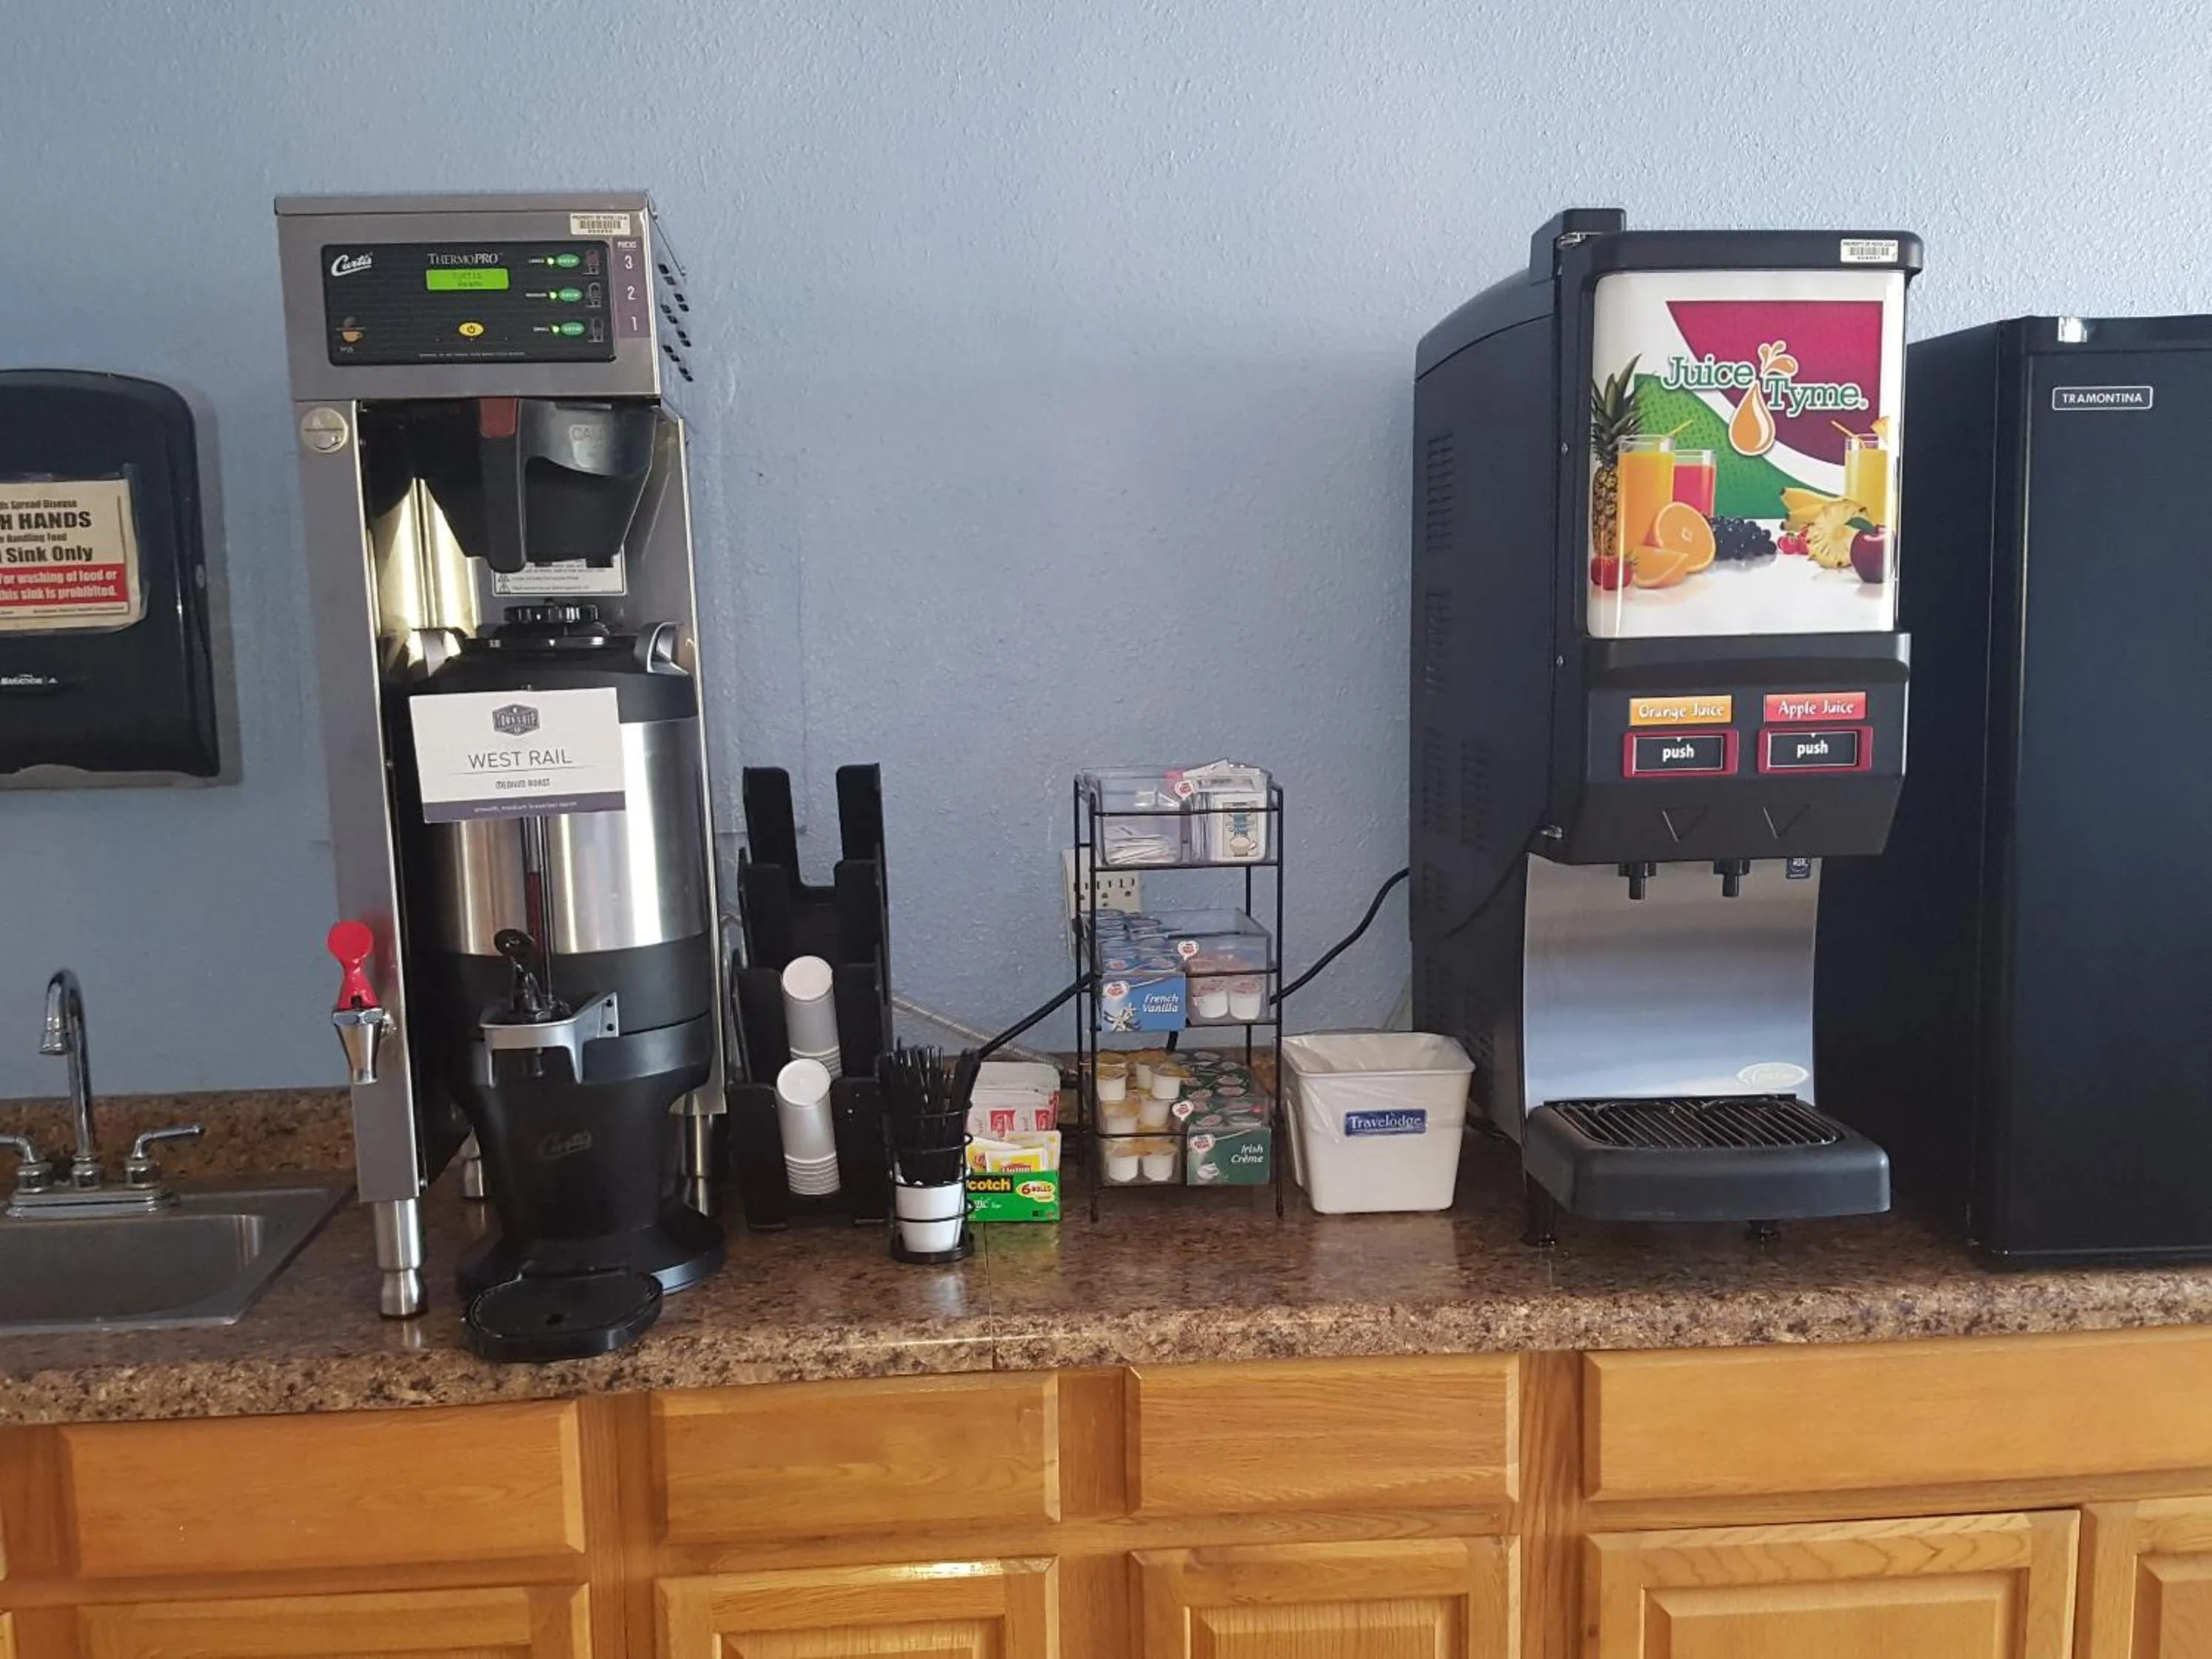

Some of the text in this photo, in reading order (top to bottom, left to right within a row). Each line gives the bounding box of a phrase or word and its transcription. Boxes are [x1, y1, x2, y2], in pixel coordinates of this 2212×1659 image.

[332, 253, 373, 276] Curtis
[624, 255, 633, 269] 3
[627, 285, 637, 301] 2
[631, 316, 637, 332] 1
[1663, 355, 1860, 416] Juice Tyme
[2062, 392, 2143, 403] TRAMONTINA
[19, 511, 92, 530] HANDS
[6, 546, 47, 563] Sink
[53, 545, 93, 562] Only
[79, 569, 104, 581] food
[106, 570, 118, 580] or
[21, 588, 45, 600] sink
[46, 587, 57, 599] is
[1638, 703, 1723, 718] Orange Juice
[1777, 697, 1855, 718] Apple Juice
[1663, 743, 1695, 762] push
[1797, 740, 1829, 758] push
[468, 748, 574, 769] WEST RAIL
[1144, 993, 1179, 1003] French
[1142, 1003, 1179, 1013] Vanilla
[1347, 1113, 1421, 1130] Travelodge
[1241, 1143, 1264, 1153] Irish
[1022, 1184, 1031, 1195] 6
